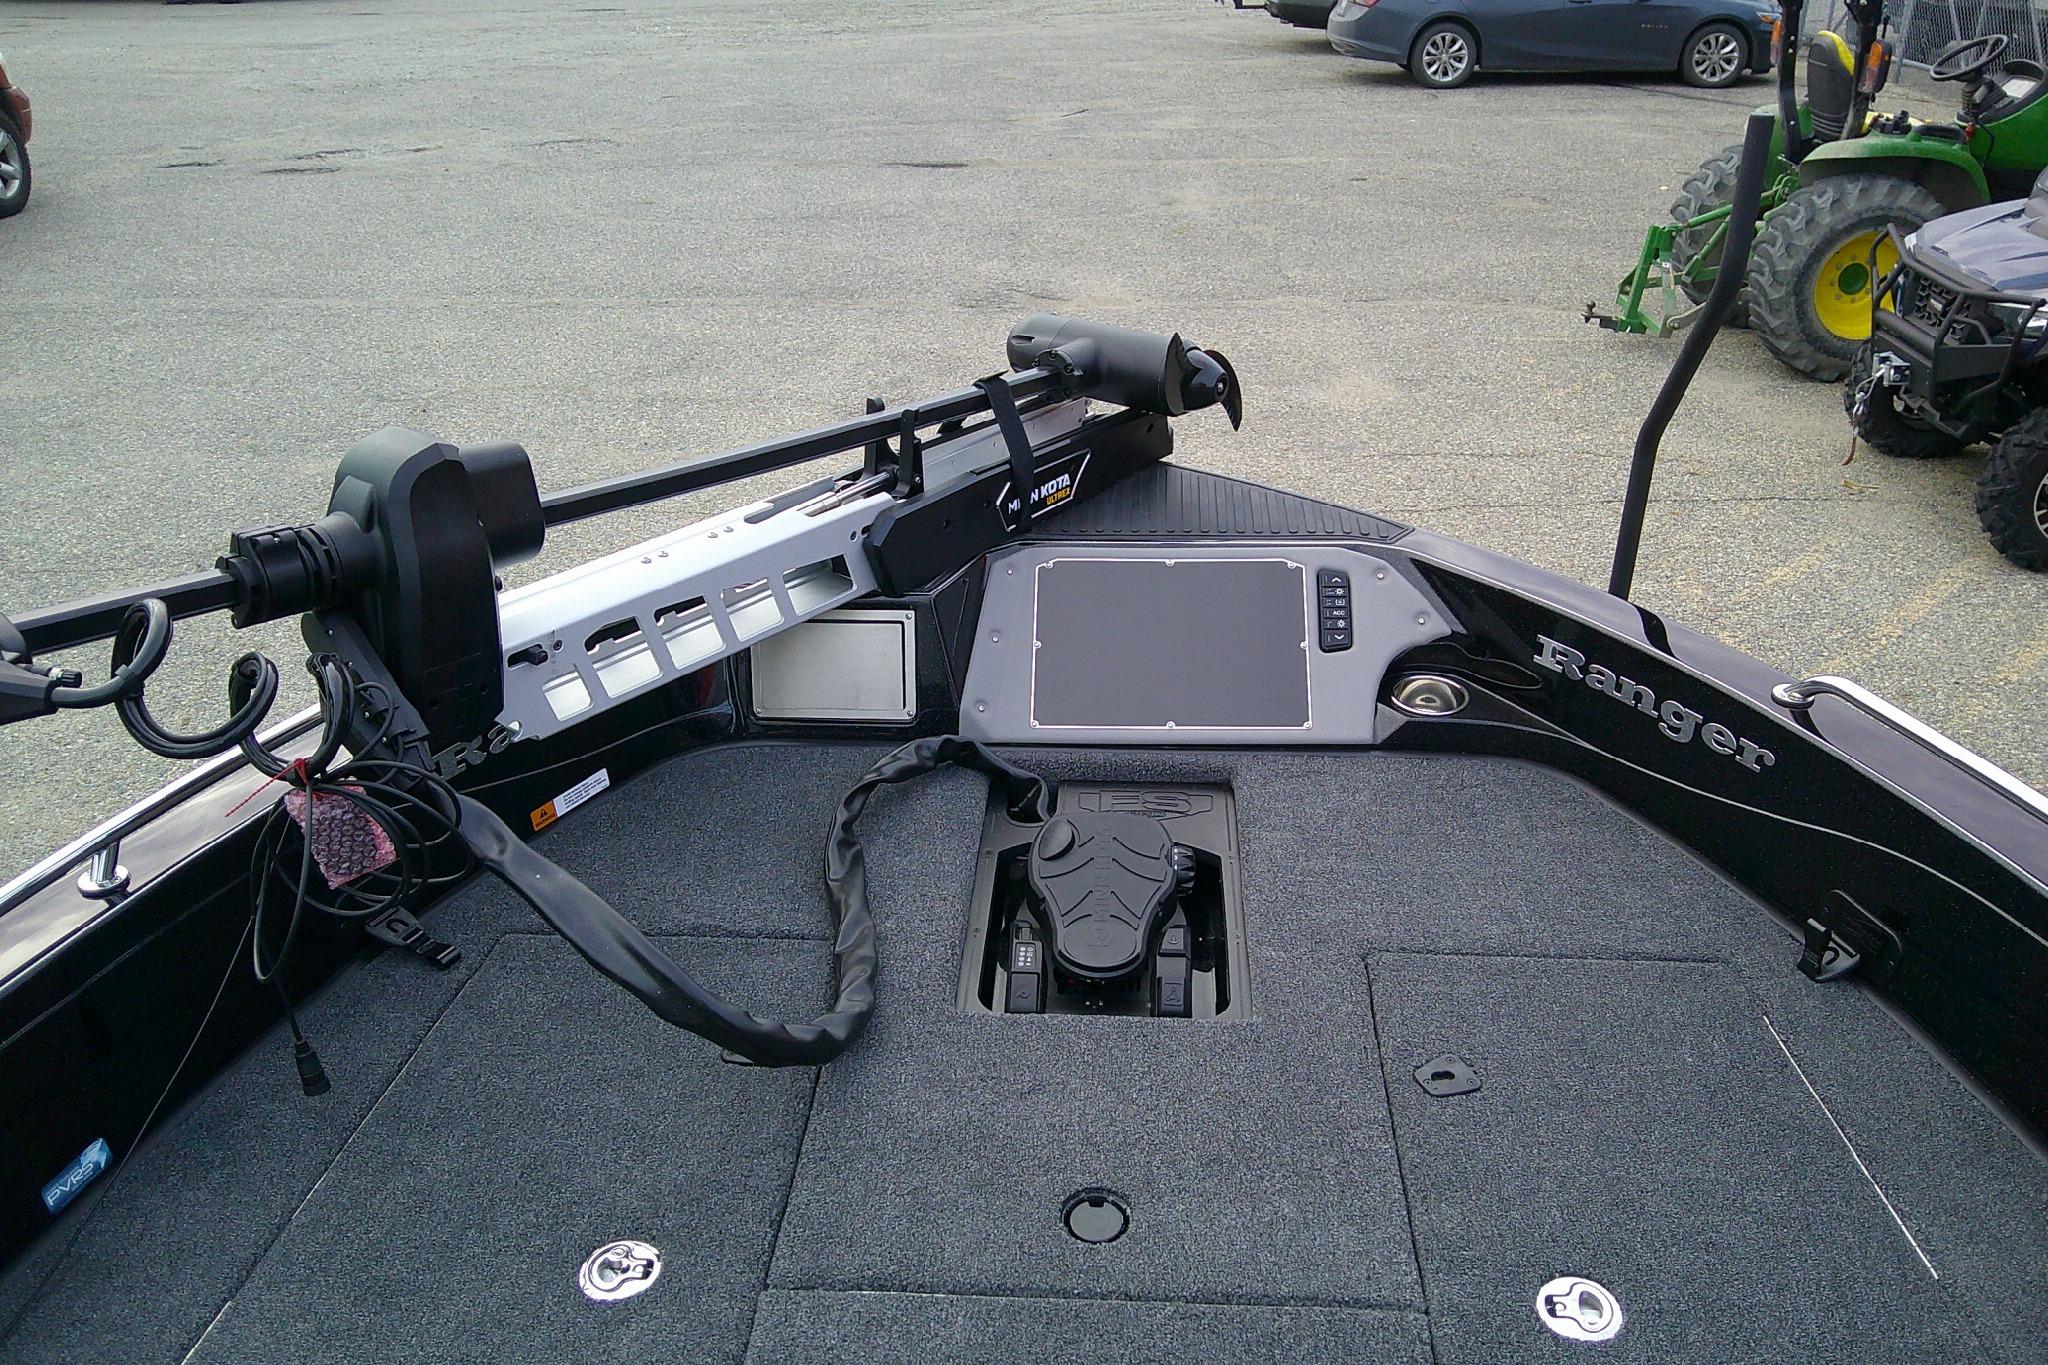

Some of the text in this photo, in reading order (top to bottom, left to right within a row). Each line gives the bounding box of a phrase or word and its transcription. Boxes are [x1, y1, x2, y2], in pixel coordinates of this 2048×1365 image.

[1008, 473, 1071, 515] MIN KOTA
[1046, 486, 1071, 506] ULTREX
[1533, 634, 1776, 773] Ranger
[47, 1162, 94, 1206] PVRS
